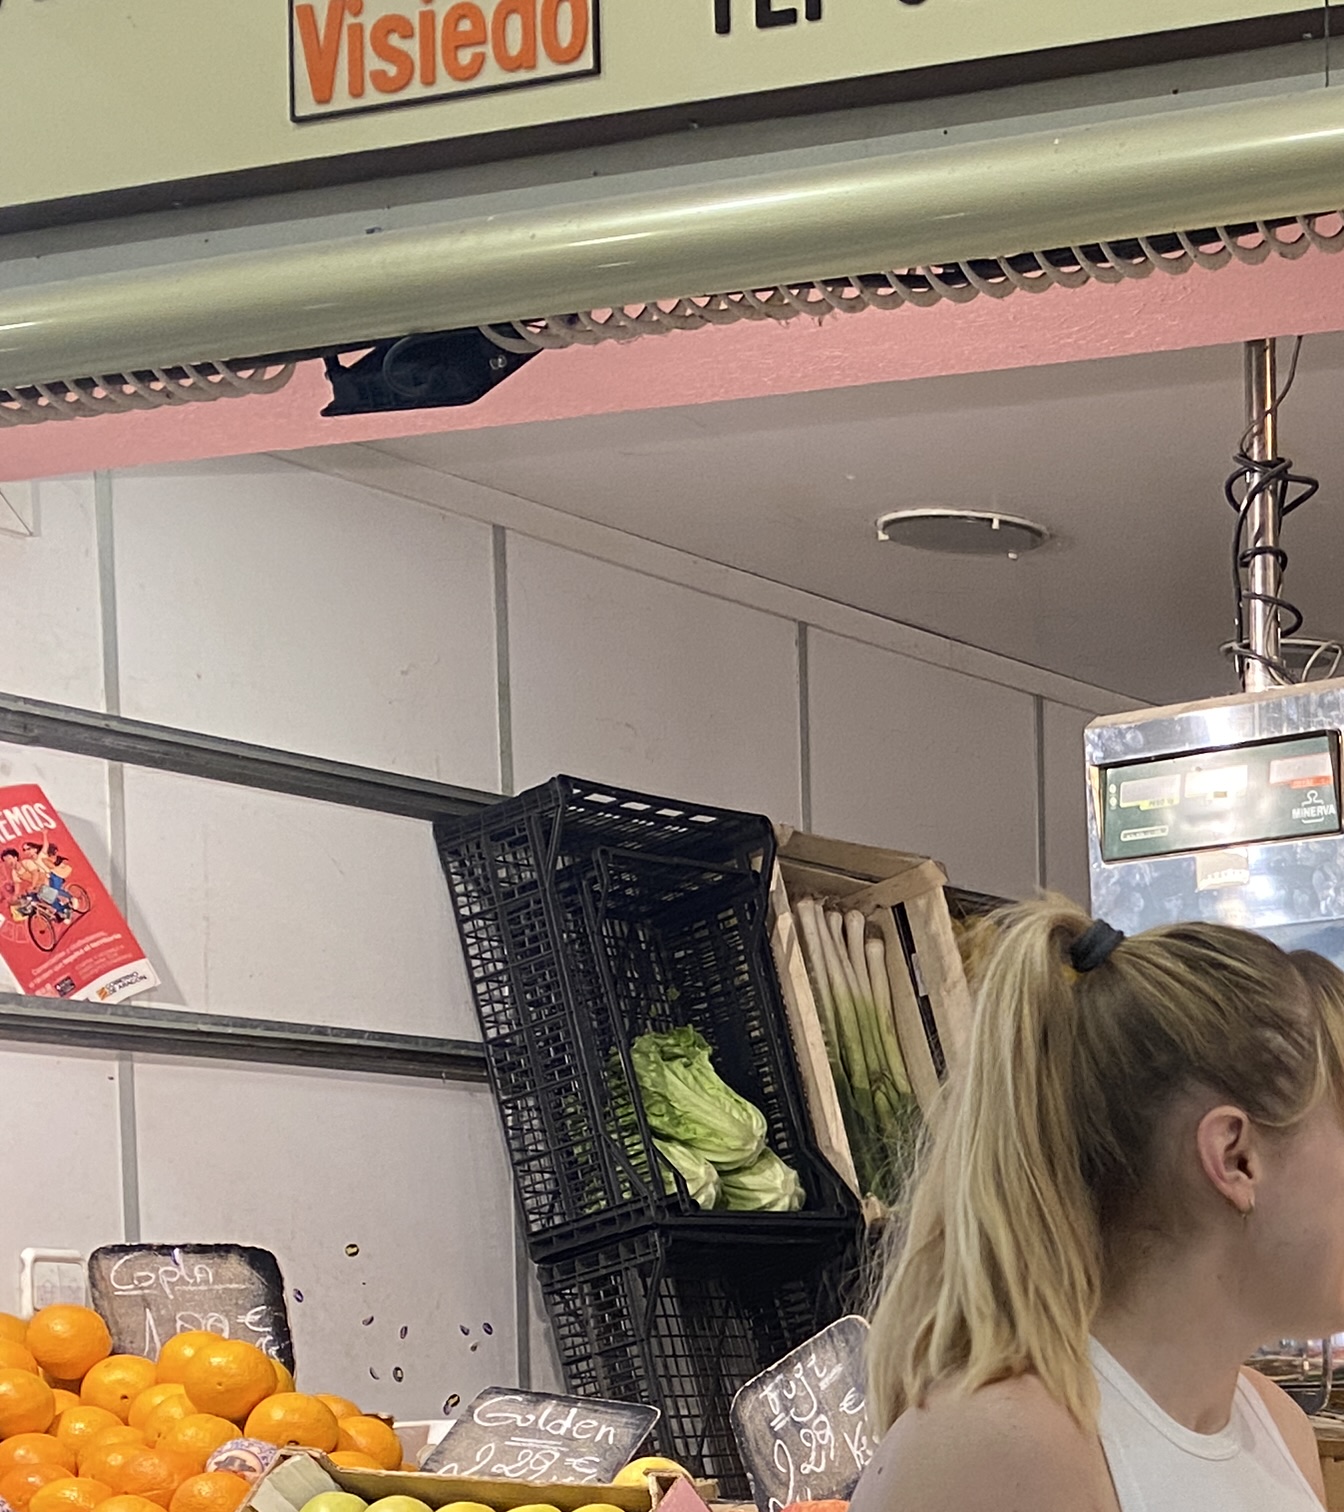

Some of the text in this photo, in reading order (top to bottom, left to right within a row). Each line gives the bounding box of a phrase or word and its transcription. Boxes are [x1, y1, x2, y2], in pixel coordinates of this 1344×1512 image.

[0, 803, 56, 843] EMOS
[1292, 804, 1336, 819] MINERVA
[473, 1395, 615, 1445] Golden
